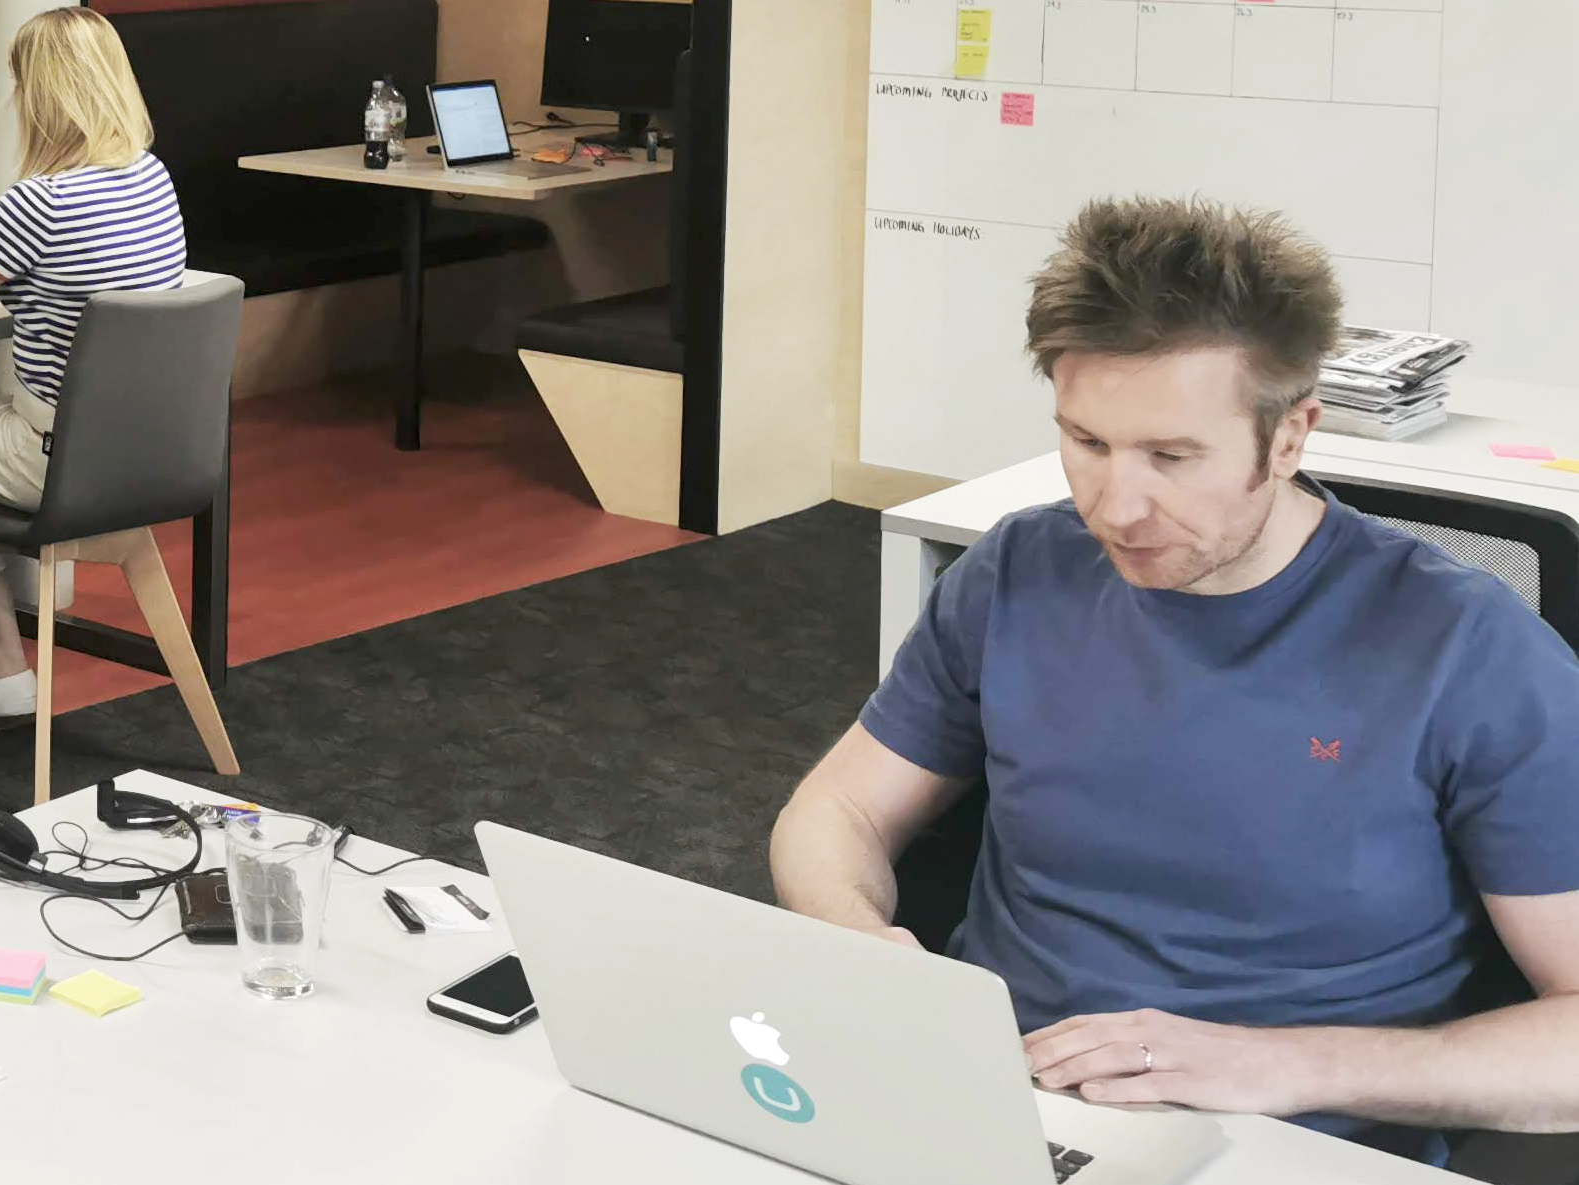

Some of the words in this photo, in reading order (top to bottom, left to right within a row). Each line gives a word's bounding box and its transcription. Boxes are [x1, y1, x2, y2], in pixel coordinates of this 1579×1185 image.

[876, 83, 933, 99] UPCOMING
[874, 216, 925, 233] UPCOMING
[933, 221, 981, 240] HOLIDAYS
